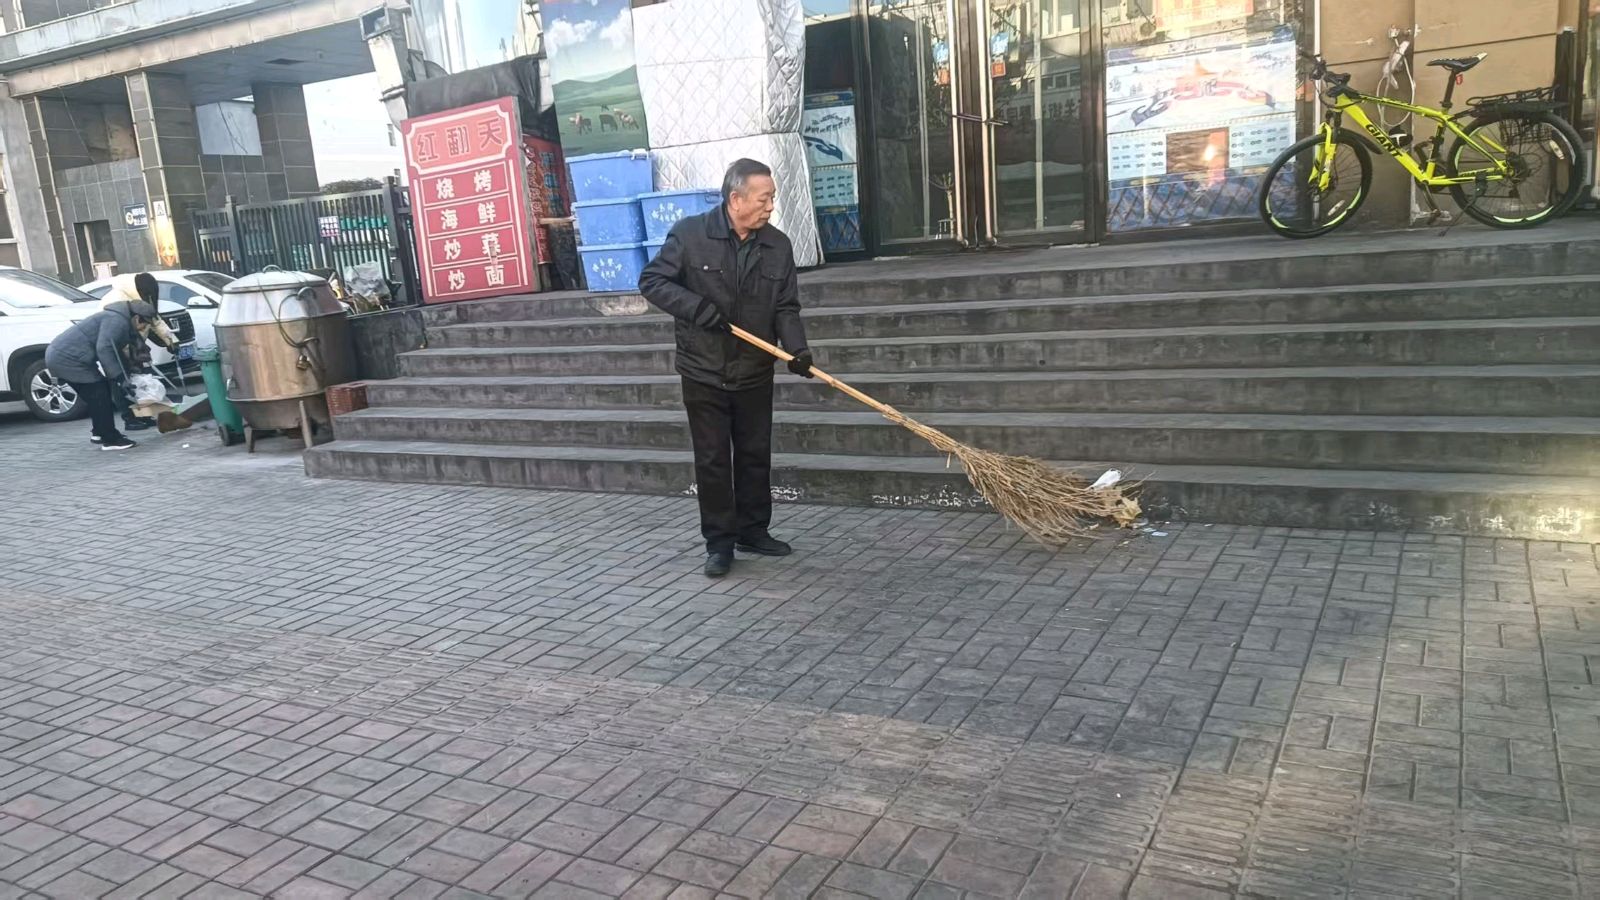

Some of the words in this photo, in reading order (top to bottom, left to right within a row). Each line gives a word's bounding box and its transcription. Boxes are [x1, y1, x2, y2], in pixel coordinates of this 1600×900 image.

[417, 118, 503, 161] 红翻天
[1365, 124, 1403, 157] GIANT
[436, 169, 493, 199] 烧烤
[440, 202, 497, 230] 海鲜
[444, 232, 501, 260] 炒菜
[447, 264, 505, 290] 炒面
